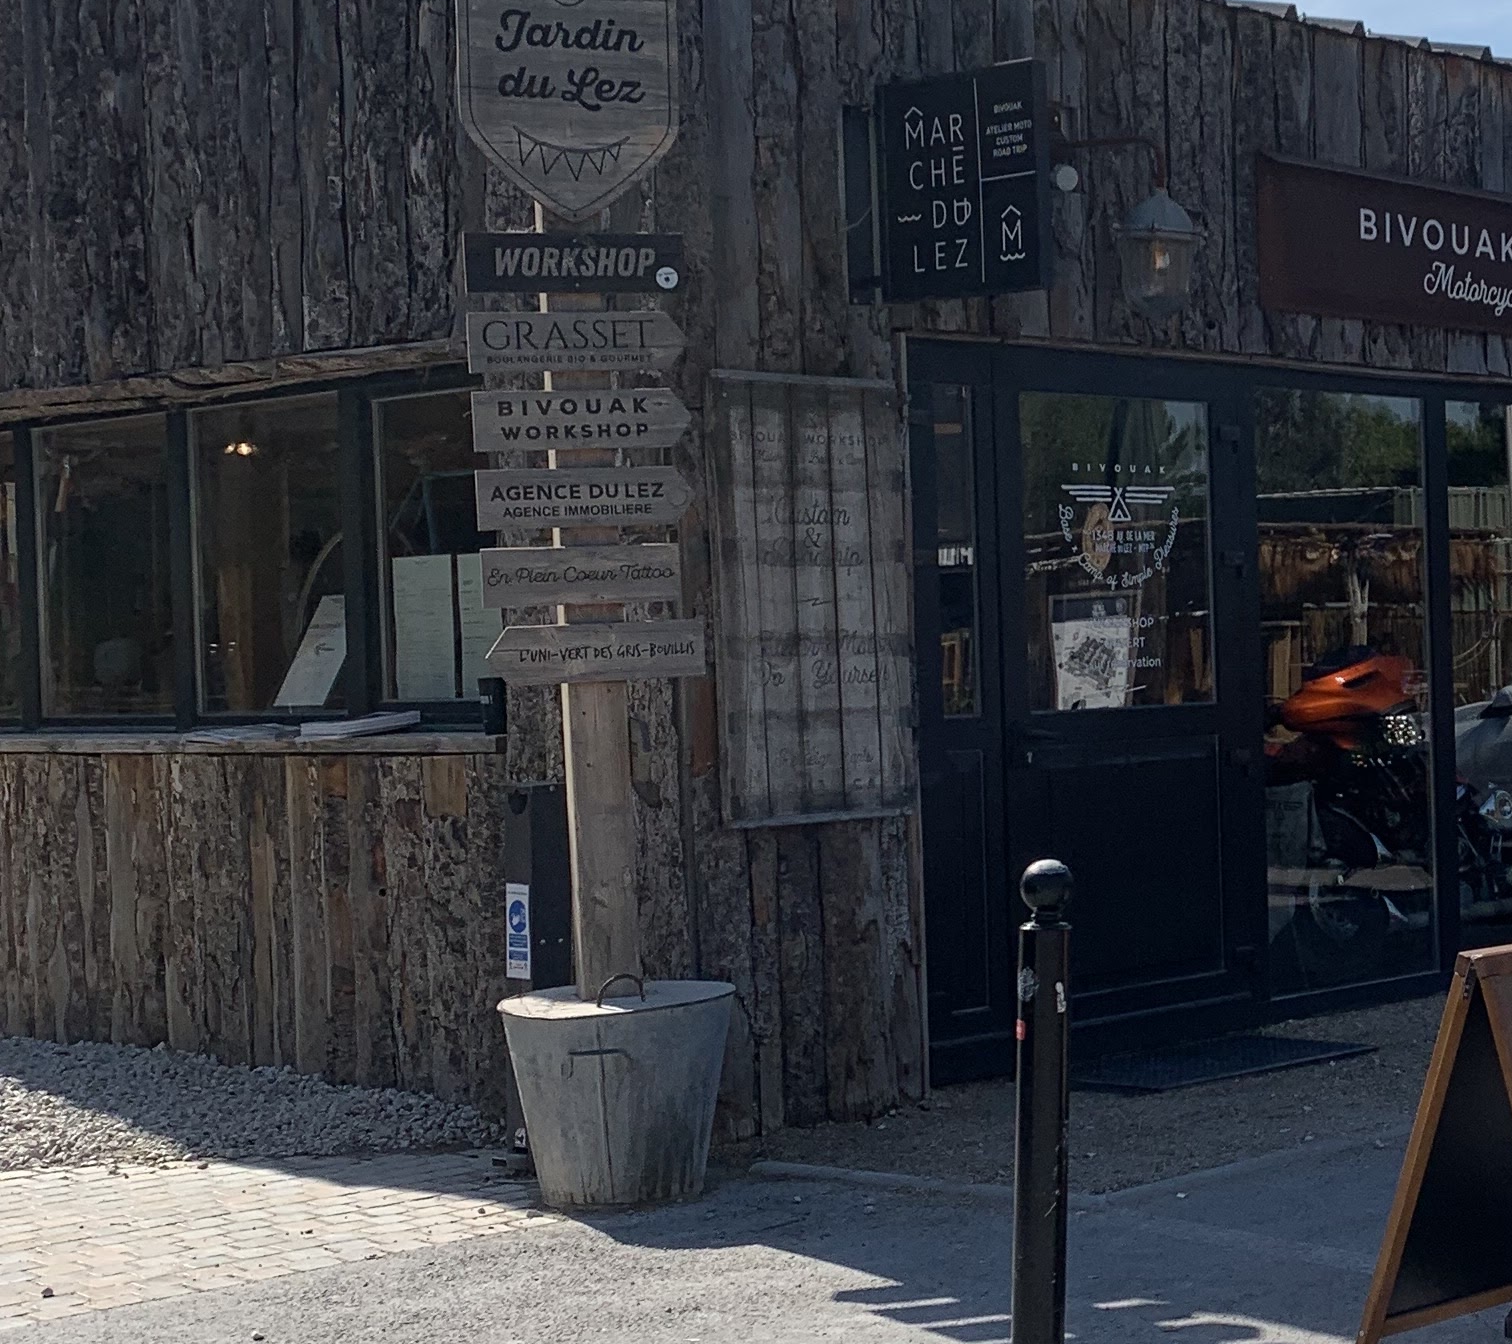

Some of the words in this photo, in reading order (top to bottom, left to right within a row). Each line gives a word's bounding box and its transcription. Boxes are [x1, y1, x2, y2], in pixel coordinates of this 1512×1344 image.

[495, 9, 644, 53] Jardin
[498, 66, 556, 99] du
[561, 66, 646, 112] Lez
[905, 113, 964, 150] MAR
[985, 122, 1012, 135] ATELIER
[1013, 119, 1032, 132] MOTO
[996, 134, 1023, 146] CUSTOM
[993, 146, 1011, 157] ROAD
[1012, 144, 1028, 156] TRIP
[933, 197, 971, 229] DU
[495, 248, 655, 277] WORKSHOP
[913, 239, 968, 273] LEZ
[482, 317, 654, 350] GRASSET
[487, 355, 563, 365] BOULANGERIE
[566, 355, 586, 363] BIO
[600, 354, 653, 364] GOURMET
[498, 397, 649, 416] BIVOUAK
[501, 423, 649, 440] WORKSHOP
[1072, 463, 1166, 474] BIVOUAK
[491, 484, 581, 502] AGENCE
[589, 484, 619, 499] DU
[624, 482, 664, 499] LEZ
[503, 505, 560, 518] AGENCE
[564, 503, 652, 517] IMMOBILIERE
[517, 566, 561, 583] Plein
[563, 565, 617, 582] Coeur
[620, 564, 675, 580] Tattoo
[594, 646, 613, 659] DES
